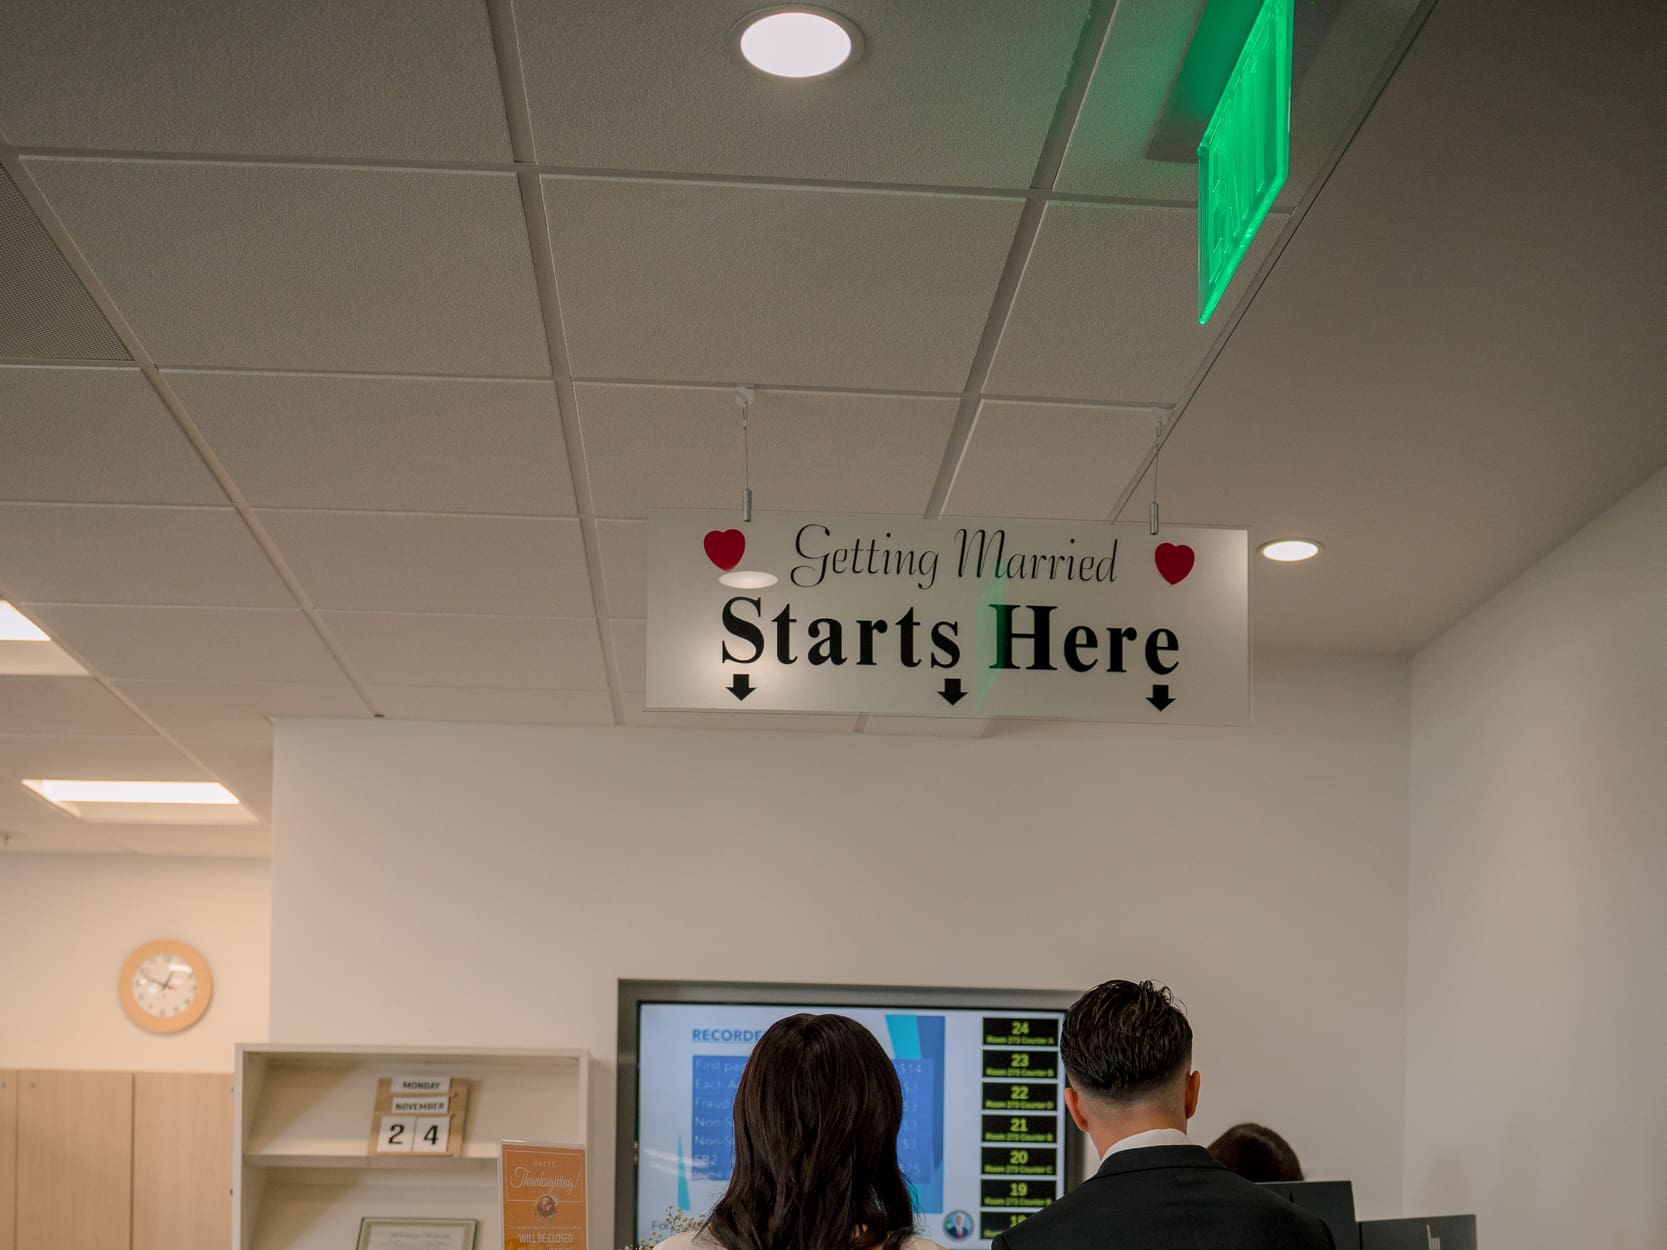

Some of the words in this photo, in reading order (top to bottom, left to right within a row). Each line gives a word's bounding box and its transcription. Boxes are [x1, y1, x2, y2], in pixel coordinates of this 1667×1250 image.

[790, 523, 940, 590] Getting
[953, 528, 1119, 583] Married
[721, 596, 961, 669] Starts
[988, 603, 1180, 675] Here
[1011, 1020, 1030, 1035] 24
[1011, 1053, 1030, 1068] 23
[402, 1081, 441, 1090] MONDAY
[1010, 1085, 1030, 1100] 22
[395, 1102, 445, 1111] NOVEMBER
[1010, 1118, 1029, 1132] 21
[388, 1123, 405, 1145] 2
[423, 1124, 440, 1145] 4
[1009, 1150, 1029, 1164] 20
[1009, 1182, 1028, 1197] 19
[519, 1233, 536, 1244] WILL
[537, 1233, 547, 1244] BE
[548, 1233, 574, 1244] CLOSED
